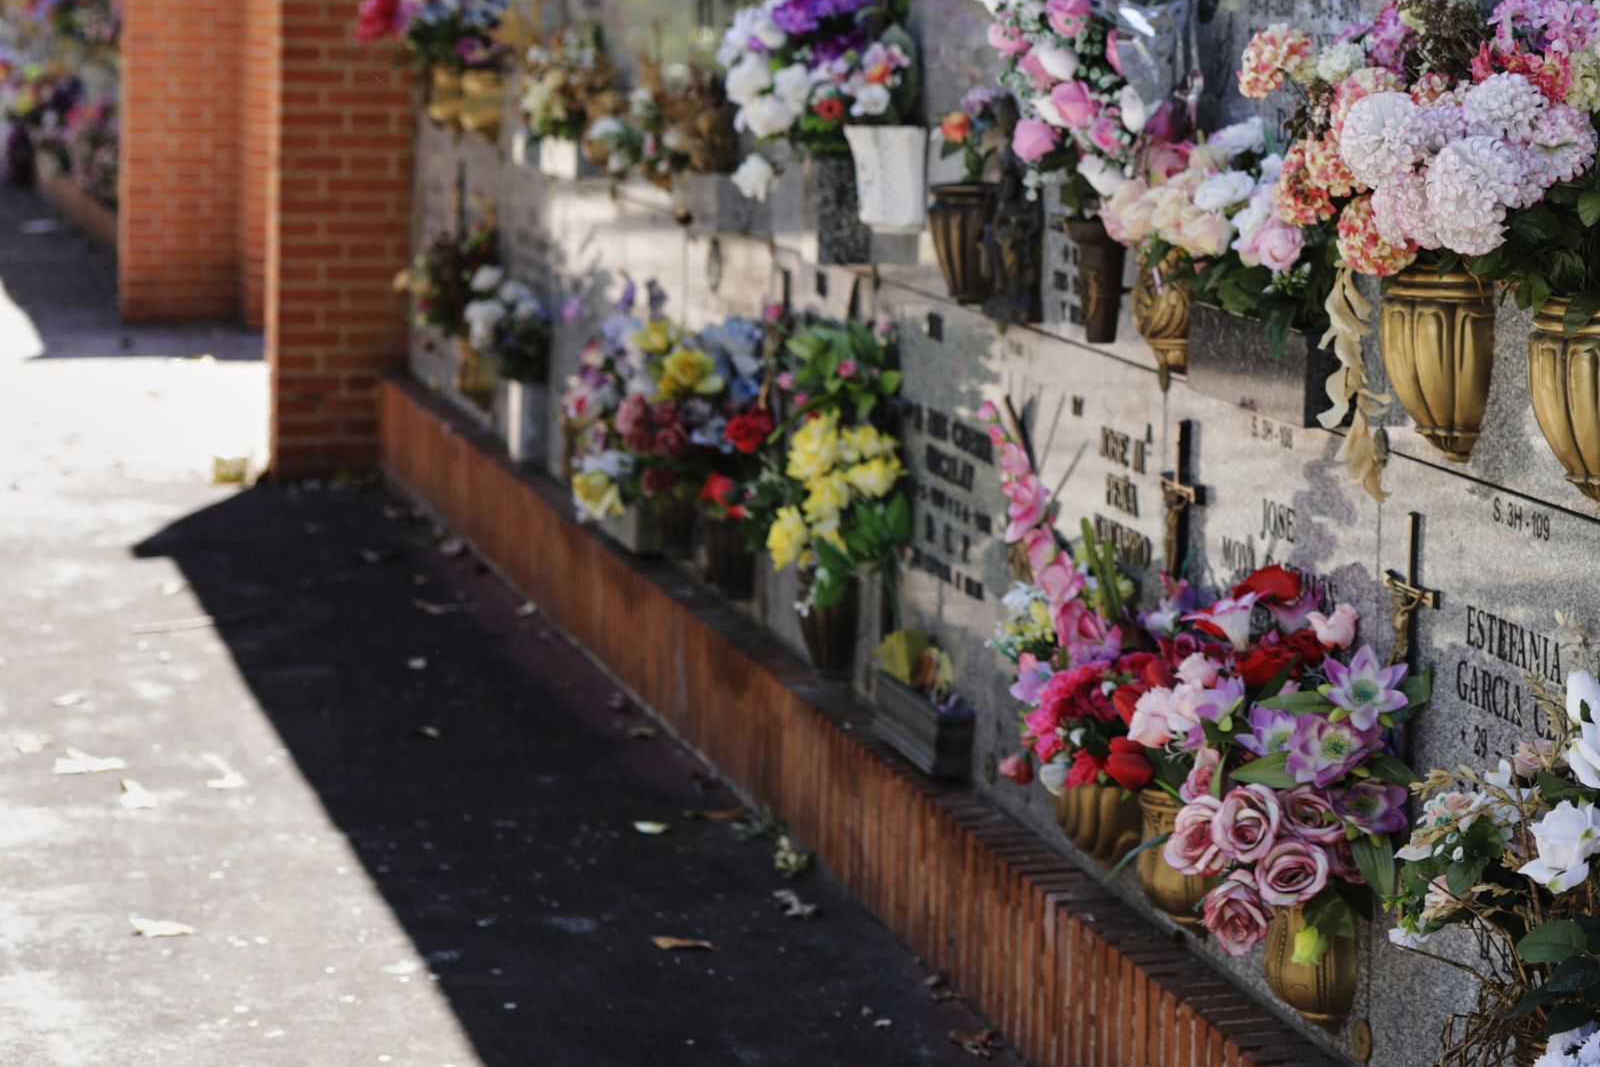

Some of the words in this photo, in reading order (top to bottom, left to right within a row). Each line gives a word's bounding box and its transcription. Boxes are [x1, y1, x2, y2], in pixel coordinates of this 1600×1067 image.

[1260, 498, 1296, 544] JOSE
[1507, 501, 1523, 532] 3H
[1531, 510, 1550, 542] 109
[1466, 605, 1563, 685] ESTEFANIA
[1456, 660, 1523, 728] GARCIA
